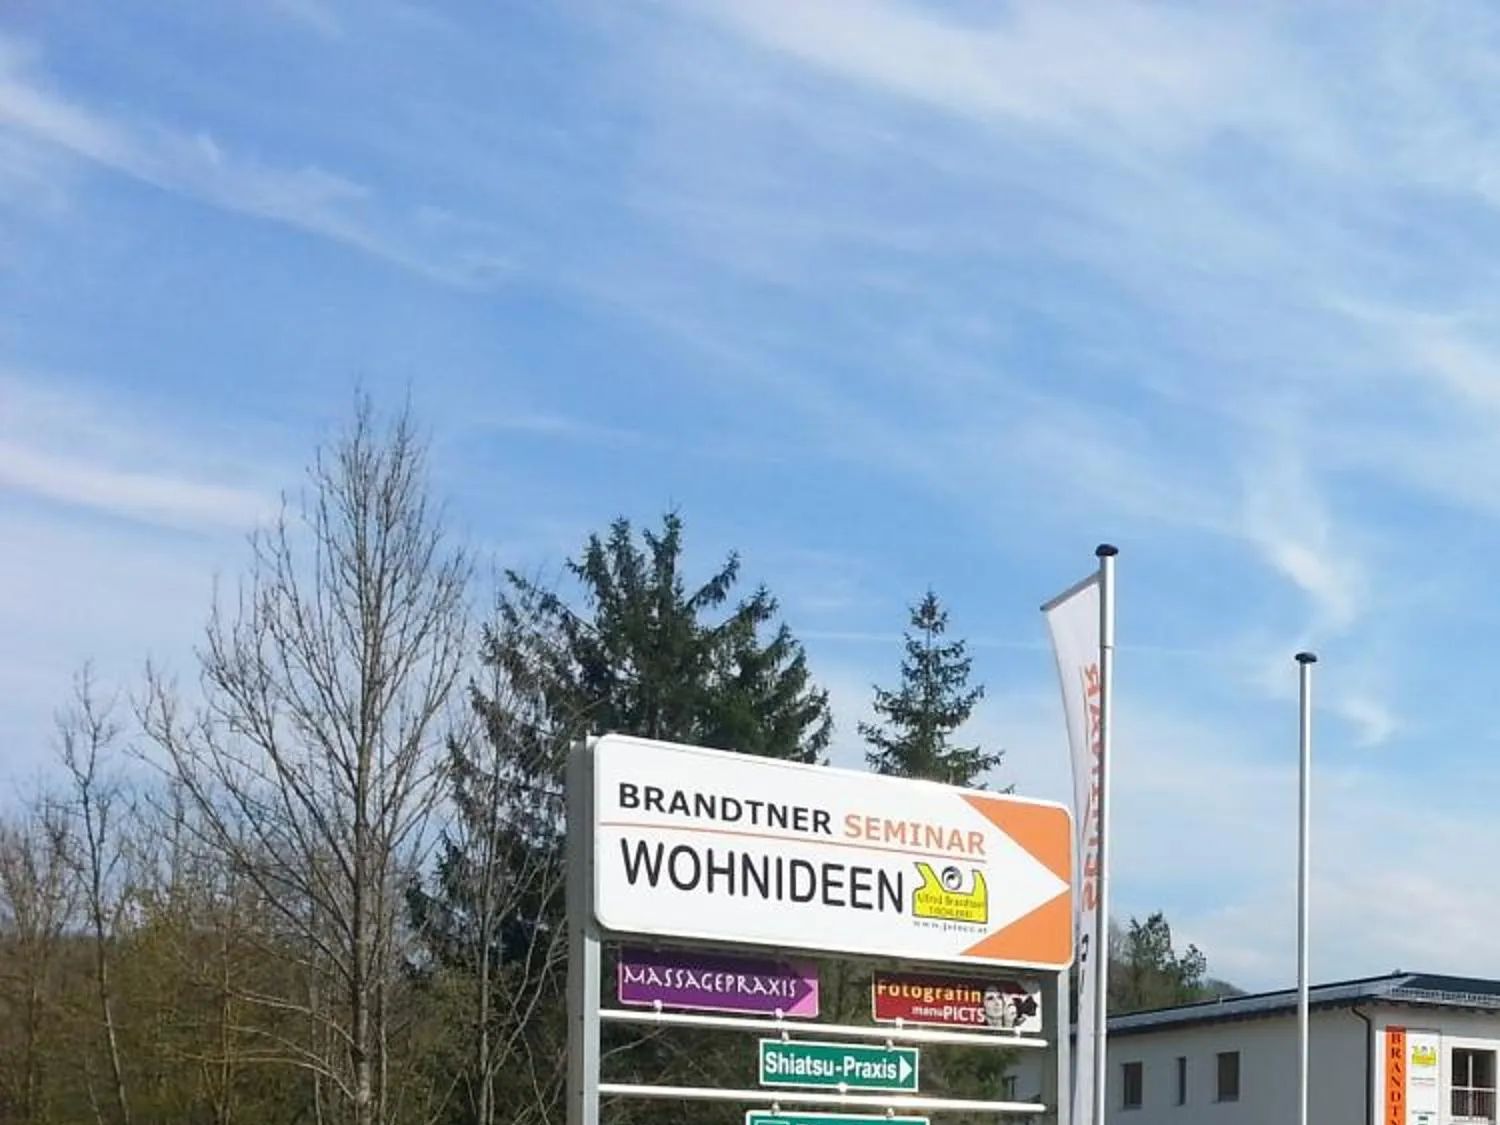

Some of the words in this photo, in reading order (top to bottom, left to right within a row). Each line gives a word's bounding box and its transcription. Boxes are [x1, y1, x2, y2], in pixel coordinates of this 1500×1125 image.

[619, 782, 833, 835] BRANDTNER
[844, 813, 986, 855] SEMINAR
[621, 837, 903, 914] WOHNIDEEN
[623, 965, 797, 997] MASSAGEPRAXIS
[877, 980, 982, 1004] Fotografin
[765, 1051, 897, 1081] Shiatsu-Praxis
